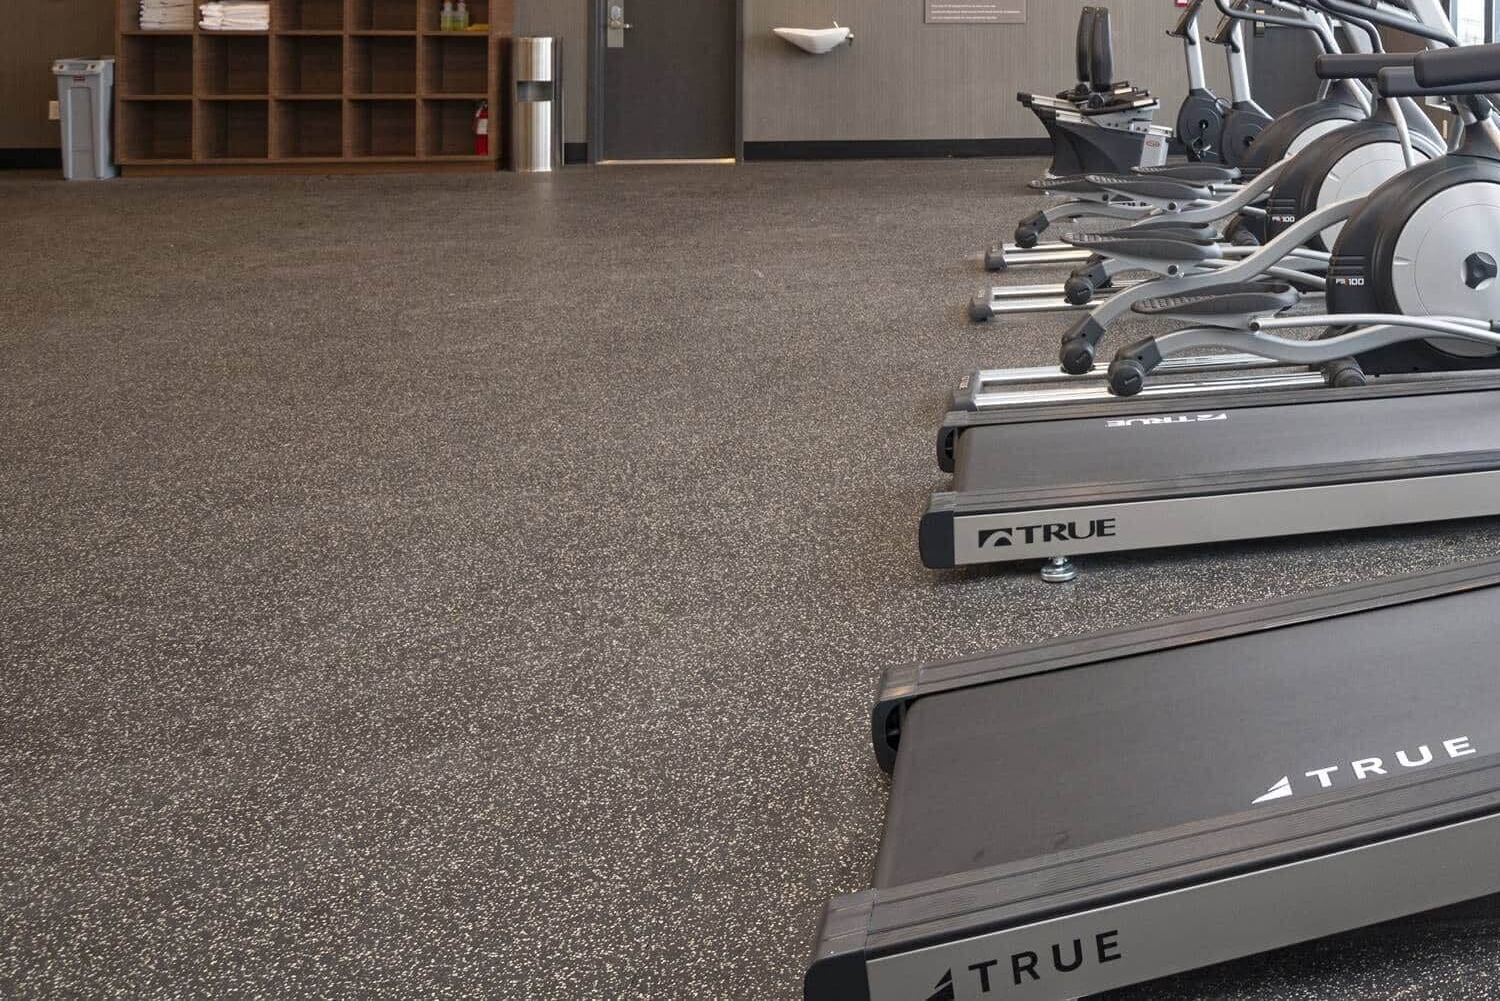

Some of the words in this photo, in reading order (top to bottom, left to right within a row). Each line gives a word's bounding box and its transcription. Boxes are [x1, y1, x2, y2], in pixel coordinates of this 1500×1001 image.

[1015, 517, 1116, 545] TRUE
[1304, 735, 1477, 788] TRUE
[967, 929, 1123, 993] TRUE
